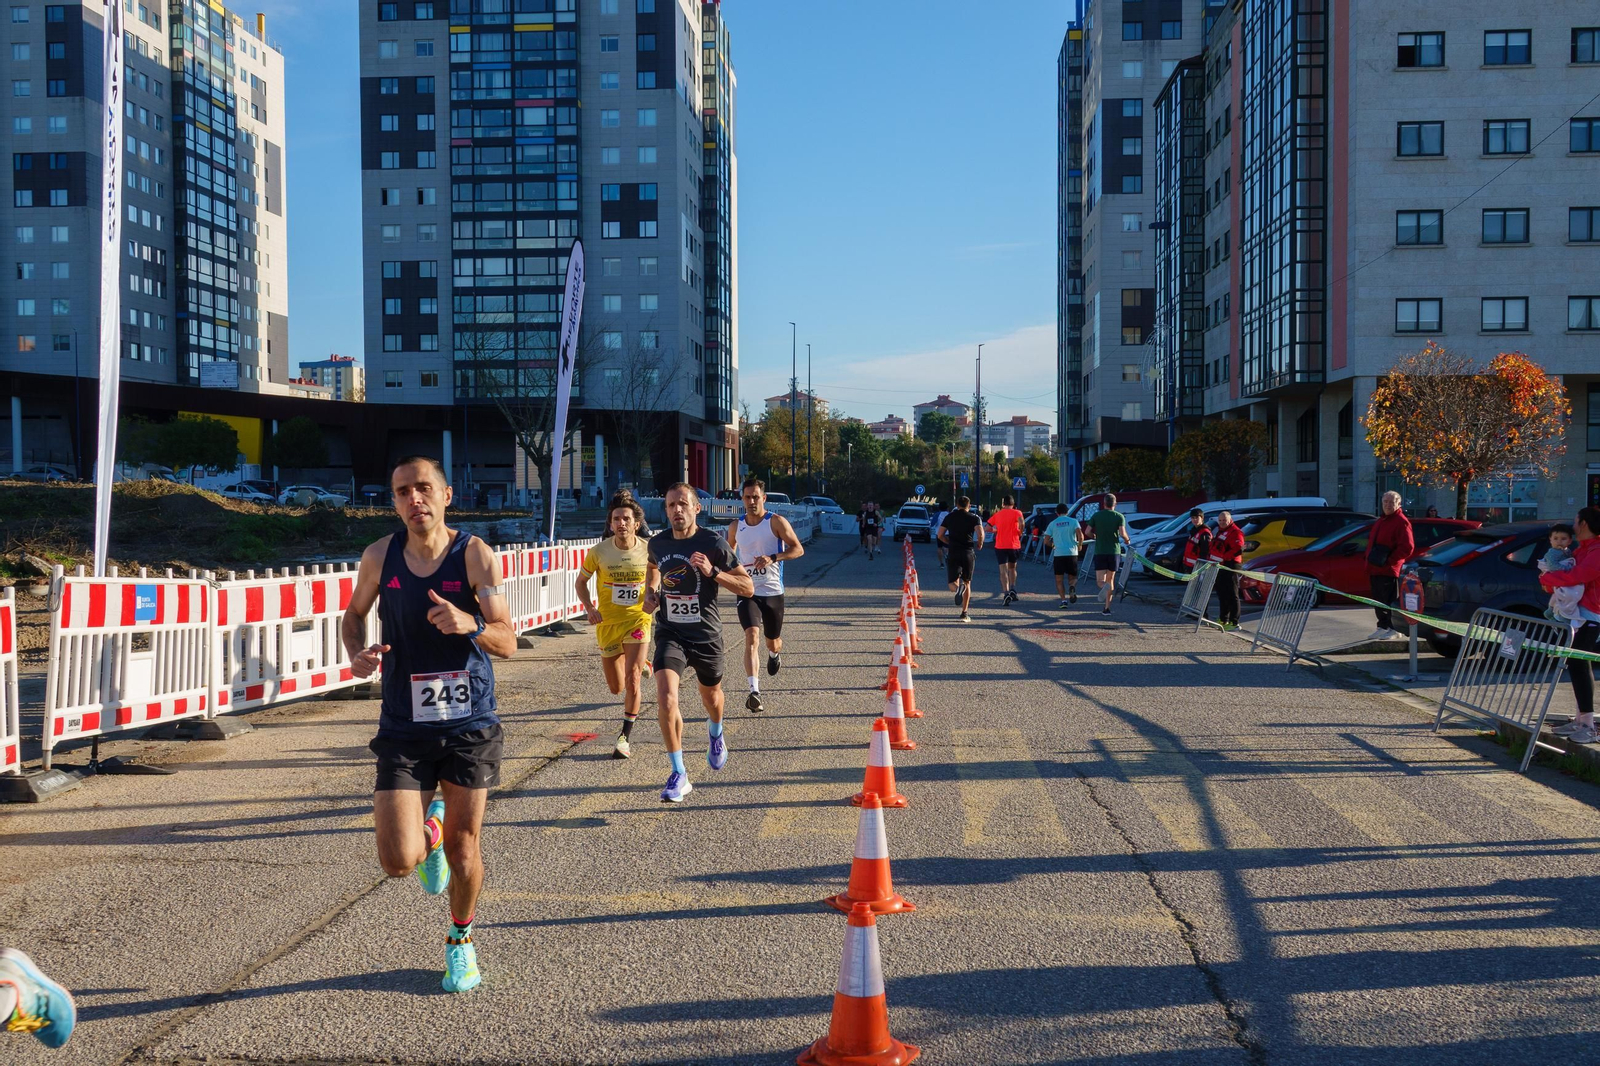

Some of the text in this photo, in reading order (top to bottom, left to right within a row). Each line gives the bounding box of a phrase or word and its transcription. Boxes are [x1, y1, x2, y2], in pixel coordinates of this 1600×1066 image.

[747, 567, 767, 577] 240
[618, 589, 639, 599] 218
[671, 603, 699, 615] 235
[421, 684, 470, 707] 243
